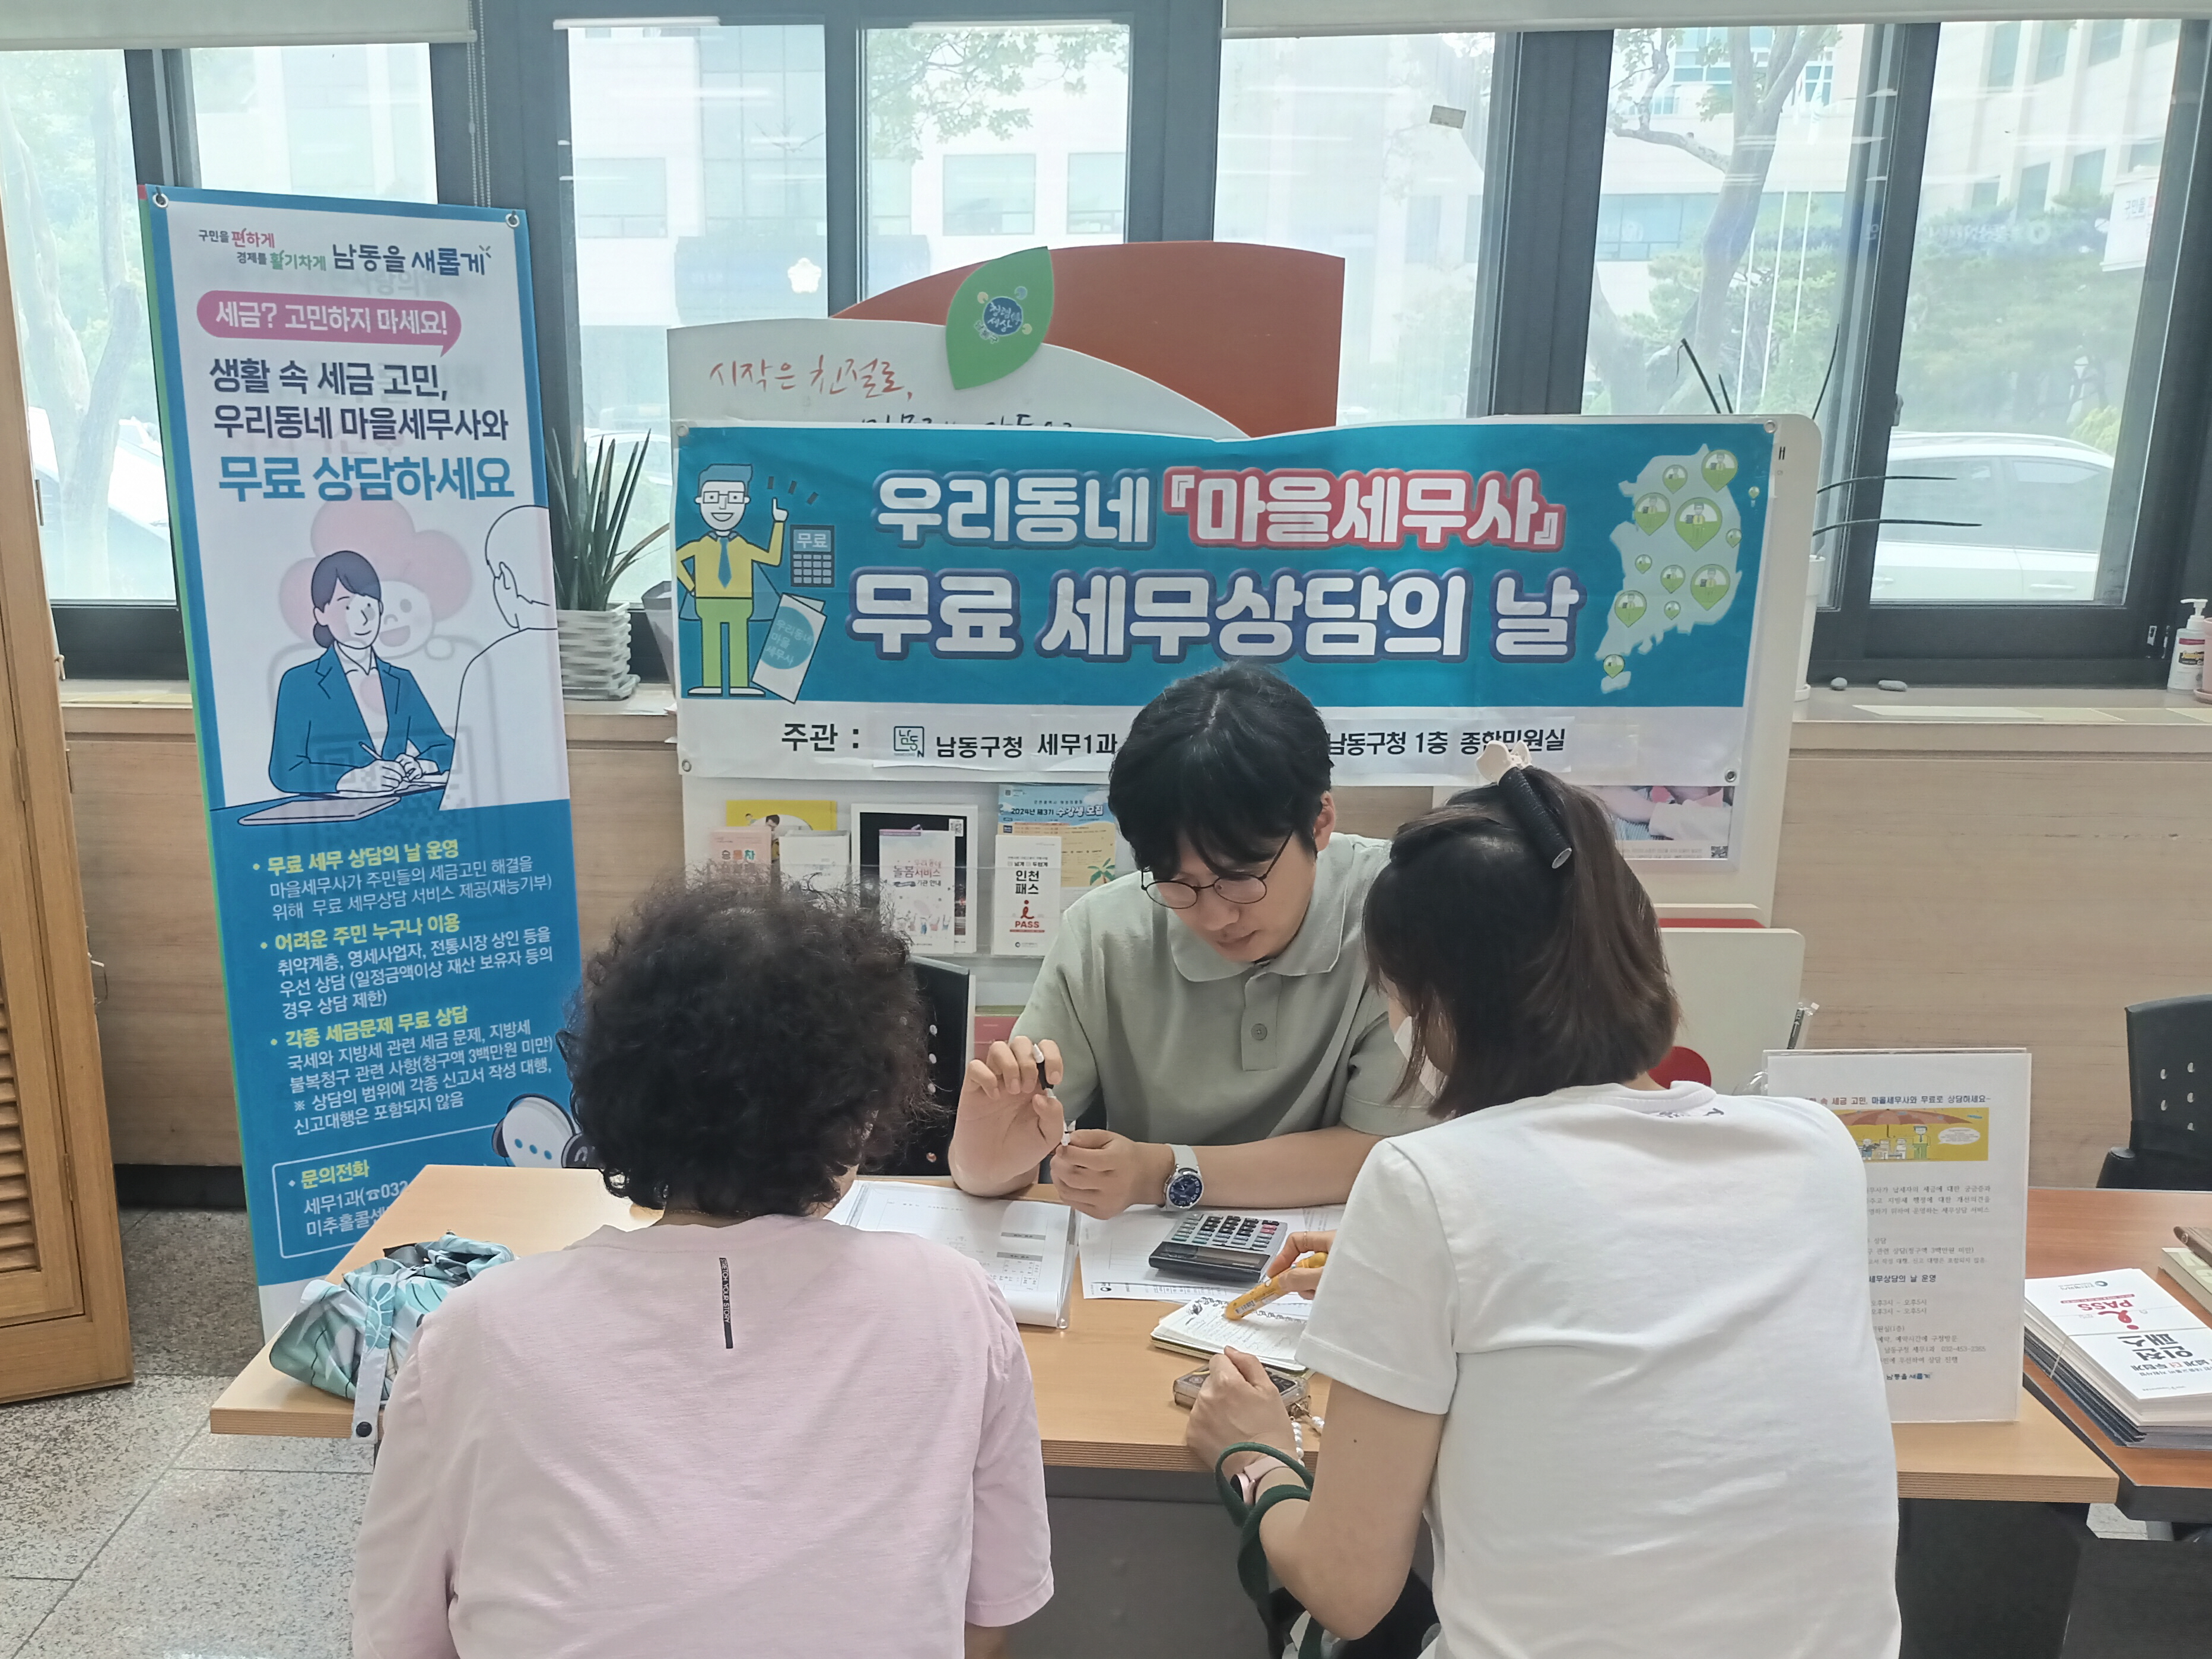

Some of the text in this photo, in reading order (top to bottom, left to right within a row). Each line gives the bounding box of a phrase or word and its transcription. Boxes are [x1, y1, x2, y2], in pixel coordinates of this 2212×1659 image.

[199, 228, 275, 249] 구민을 편하게
[237, 244, 487, 275] 경제를 활기차게 남동을 새롭게
[216, 301, 447, 335] 세금? 고민하지 마세요!
[209, 358, 447, 401] 생활 속 세금 고민,
[710, 355, 913, 400] 시작은 친절로,
[214, 405, 508, 441] 우리동네 마을세무사와
[219, 456, 514, 502] 무료 상담하세요
[876, 475, 1152, 544] 우리동네
[796, 532, 828, 549] 무료
[776, 619, 813, 646] 우리동네
[851, 573, 1581, 657] 무료 세무상담의 날
[781, 723, 838, 752] 주관
[936, 736, 1022, 758] 남동구청
[1037, 733, 1118, 755] 세무1과
[1329, 732, 1406, 756] 남동구청
[1416, 732, 1448, 754] 1층
[1056, 806, 1085, 817] 수강생
[1086, 805, 1104, 816] 모집
[268, 840, 459, 876] 무료 세무 상담의 날 운영
[1016, 870, 1040, 882] 인천
[270, 856, 533, 900] 마을세무사가 주민들의 세금고민 해결을
[1015, 883, 1039, 895] 패스
[273, 875, 552, 921] 위해 무료 세무상담 서비스 제공(재능기부)
[275, 914, 460, 952] 어려운 주민 누구나 이용
[278, 926, 551, 977] 취약계층, 영세사업자, 전통시장 상인 등을
[280, 946, 553, 997] 우선 상담 (일정금액이상 재산 보유자 등의
[282, 989, 387, 1020] 경우 상담 제한)
[285, 1005, 468, 1048] 각종 세금문제 무료 상담
[288, 1019, 531, 1071] 국세와 지방세 관련 세금 문제, 지방세
[290, 1037, 553, 1094] 불복청구 관련 사항(청구액 3백만원 미만)
[312, 1056, 552, 1112] 상담의 범위에 각종 신고서 작성 대행,
[1871, 1096, 1917, 1104] 마을세무사와
[294, 1091, 465, 1135] 신고대행은 포함되지 않음
[301, 1159, 370, 1190] 문의전화
[1922, 1275, 1936, 1283] 운영
[2077, 1299, 2134, 1311] PASS
[2117, 1333, 2179, 1347] 패스
[2132, 1346, 2194, 1361] 인천
